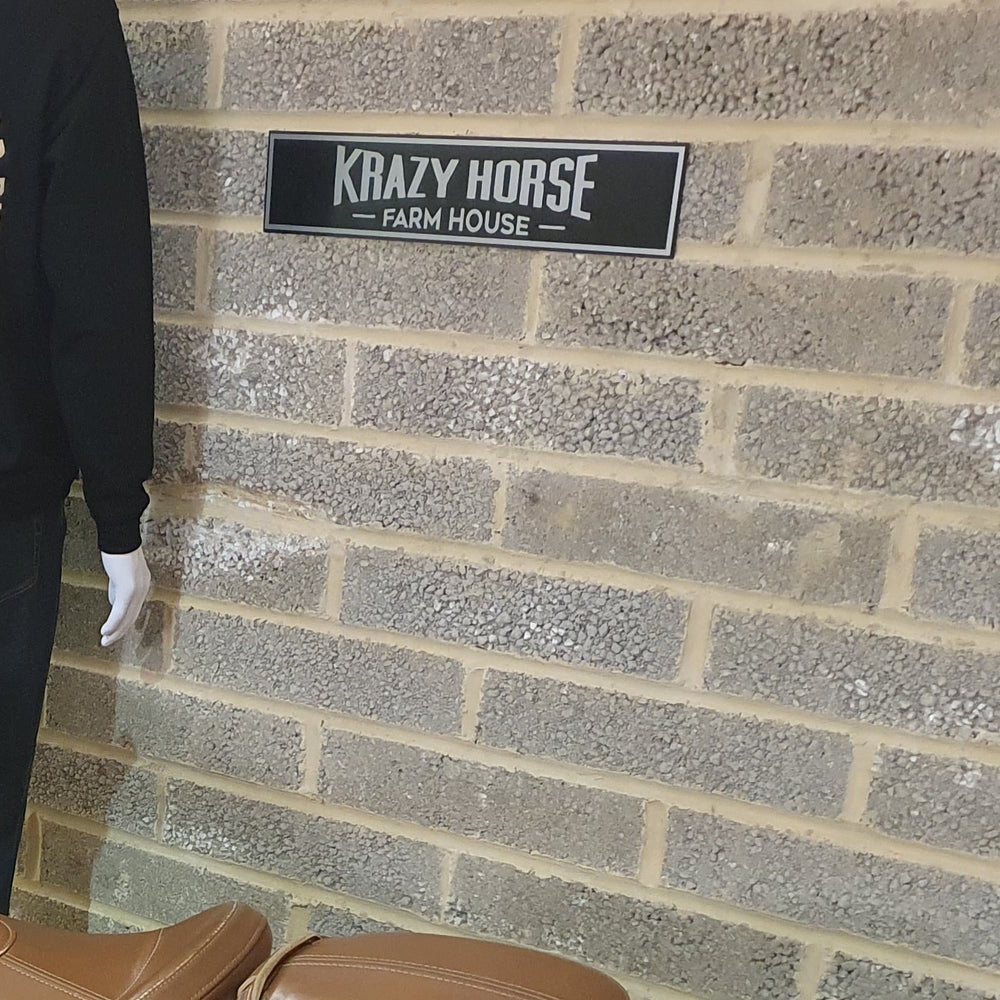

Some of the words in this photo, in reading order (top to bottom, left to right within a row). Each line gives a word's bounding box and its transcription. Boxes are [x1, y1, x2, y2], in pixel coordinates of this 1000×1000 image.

[333, 145, 460, 207] KRAZY
[466, 153, 598, 221] HORSE
[382, 207, 442, 231] FARM
[448, 206, 531, 236] HOUSE
